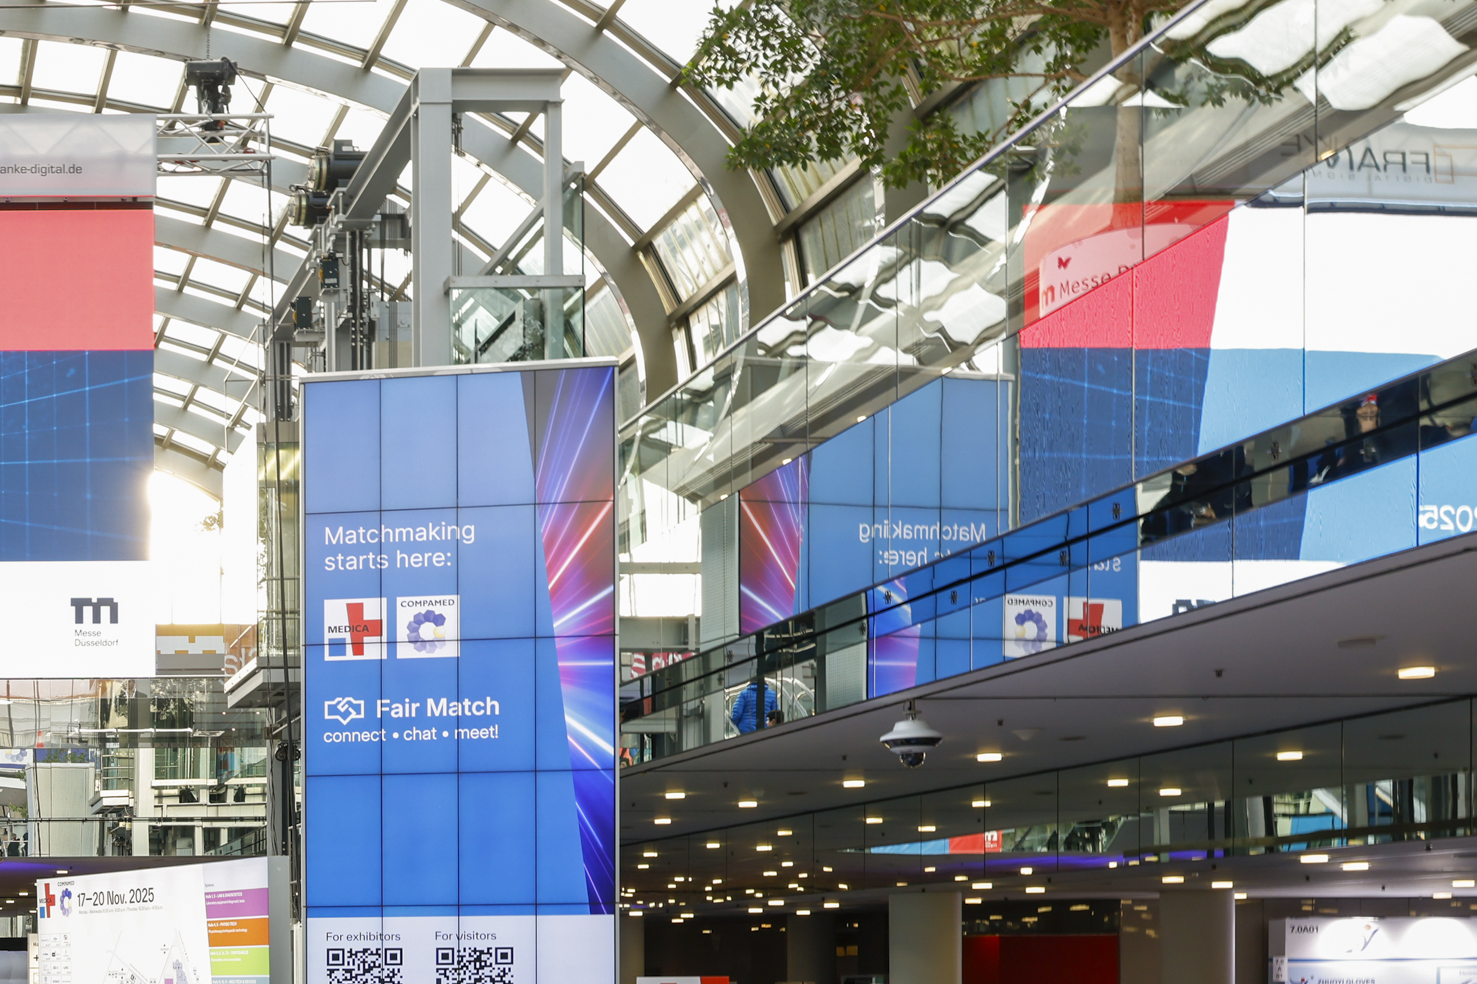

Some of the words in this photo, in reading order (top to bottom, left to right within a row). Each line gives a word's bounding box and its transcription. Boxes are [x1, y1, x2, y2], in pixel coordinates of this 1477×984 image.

[324, 522, 475, 545] Matchmaking
[324, 552, 389, 571] starts
[397, 549, 452, 568] here:
[400, 599, 455, 608] COMPAMED
[74, 629, 102, 638] Messe
[328, 624, 370, 633] MEDICA
[74, 638, 119, 648] Düsseldorf
[377, 698, 420, 719] Fair
[427, 696, 500, 717] Match
[324, 728, 386, 743] connect
[403, 727, 437, 741] chat
[455, 724, 499, 740] meet!
[107, 890, 127, 906] Nov.
[129, 887, 155, 904] 2025
[326, 932, 344, 942] For
[346, 932, 401, 942] exhibitors
[435, 931, 454, 941] For
[456, 931, 497, 941] visitors
